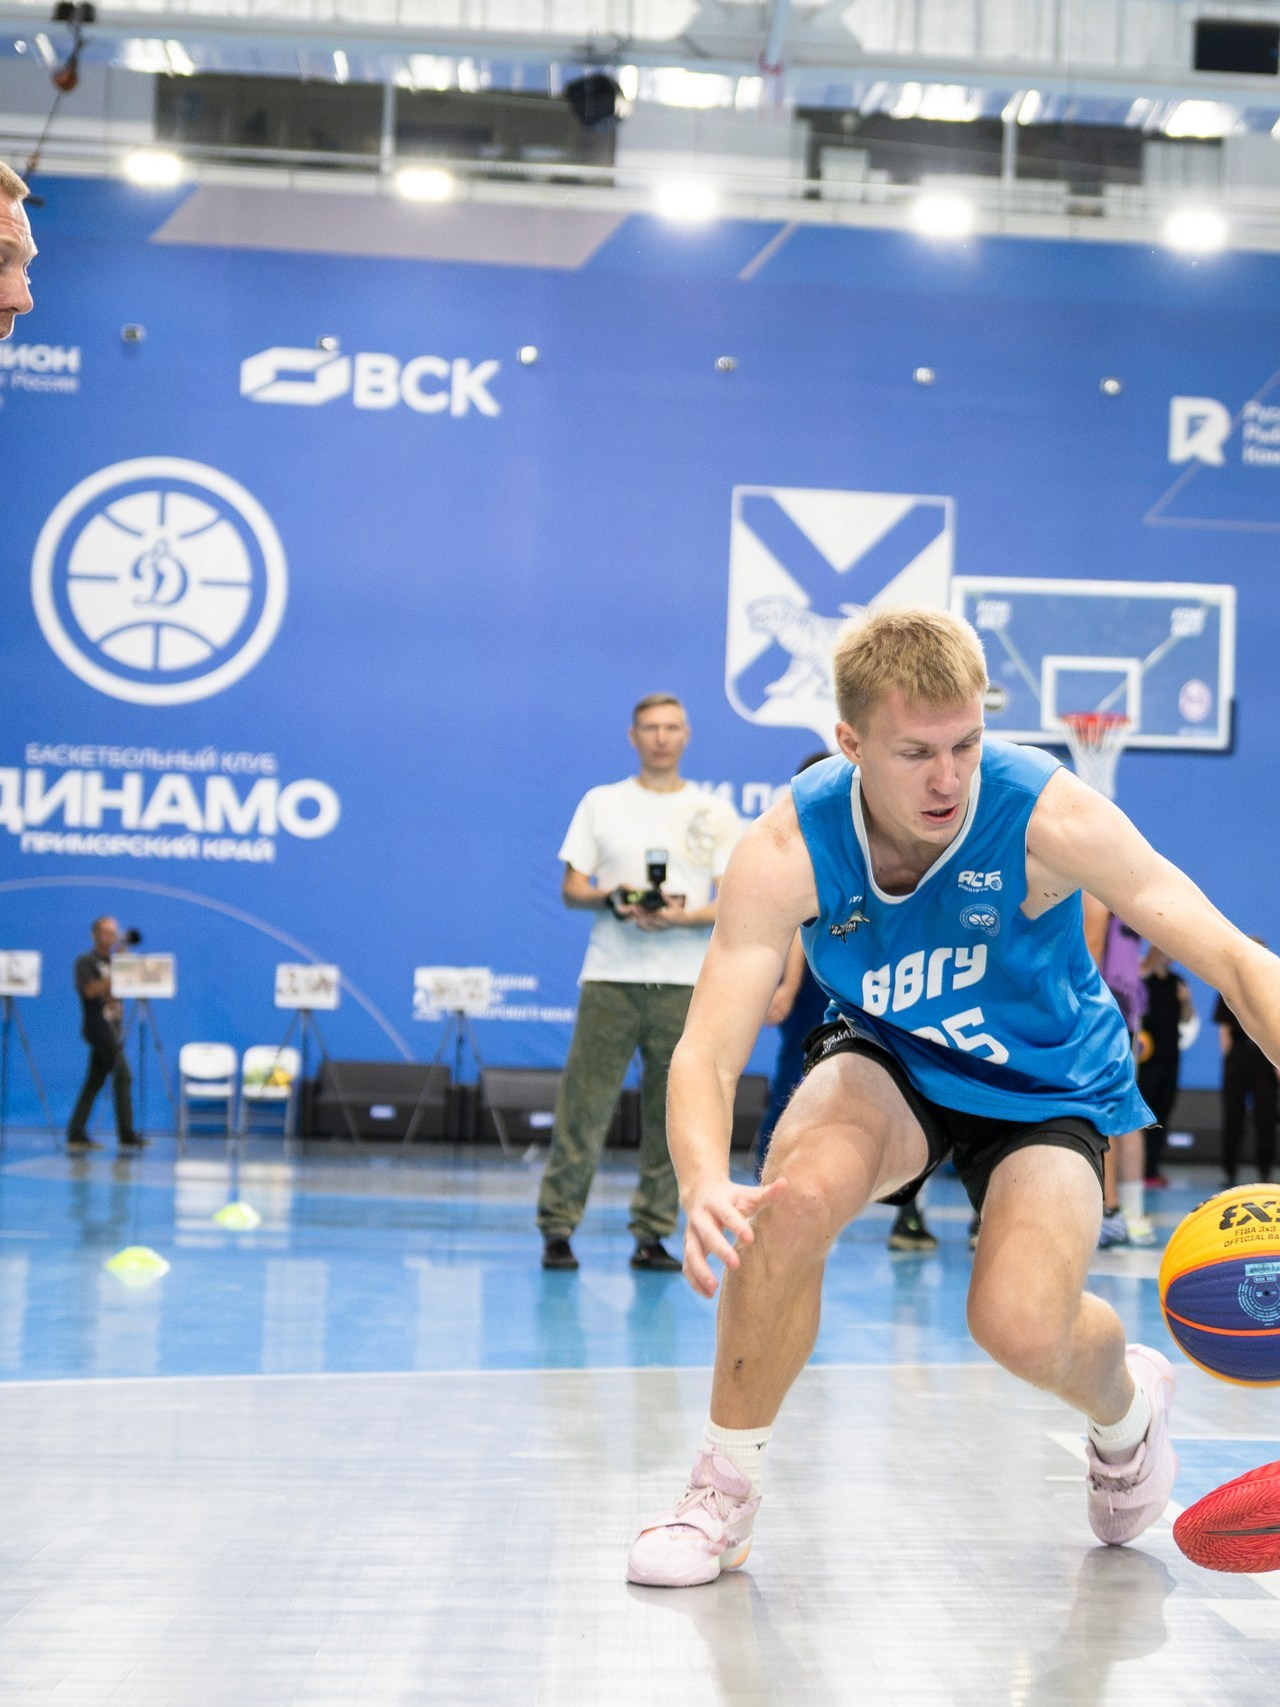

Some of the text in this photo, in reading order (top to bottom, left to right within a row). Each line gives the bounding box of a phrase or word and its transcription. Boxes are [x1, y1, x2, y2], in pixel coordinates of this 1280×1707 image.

[353, 352, 500, 418] ВСК
[20, 830, 275, 864] ПРИМОРСКИЙ КРАЙ
[1223, 1234, 1265, 1248] OFFICIAL
[1234, 1226, 1257, 1237] FIBA
